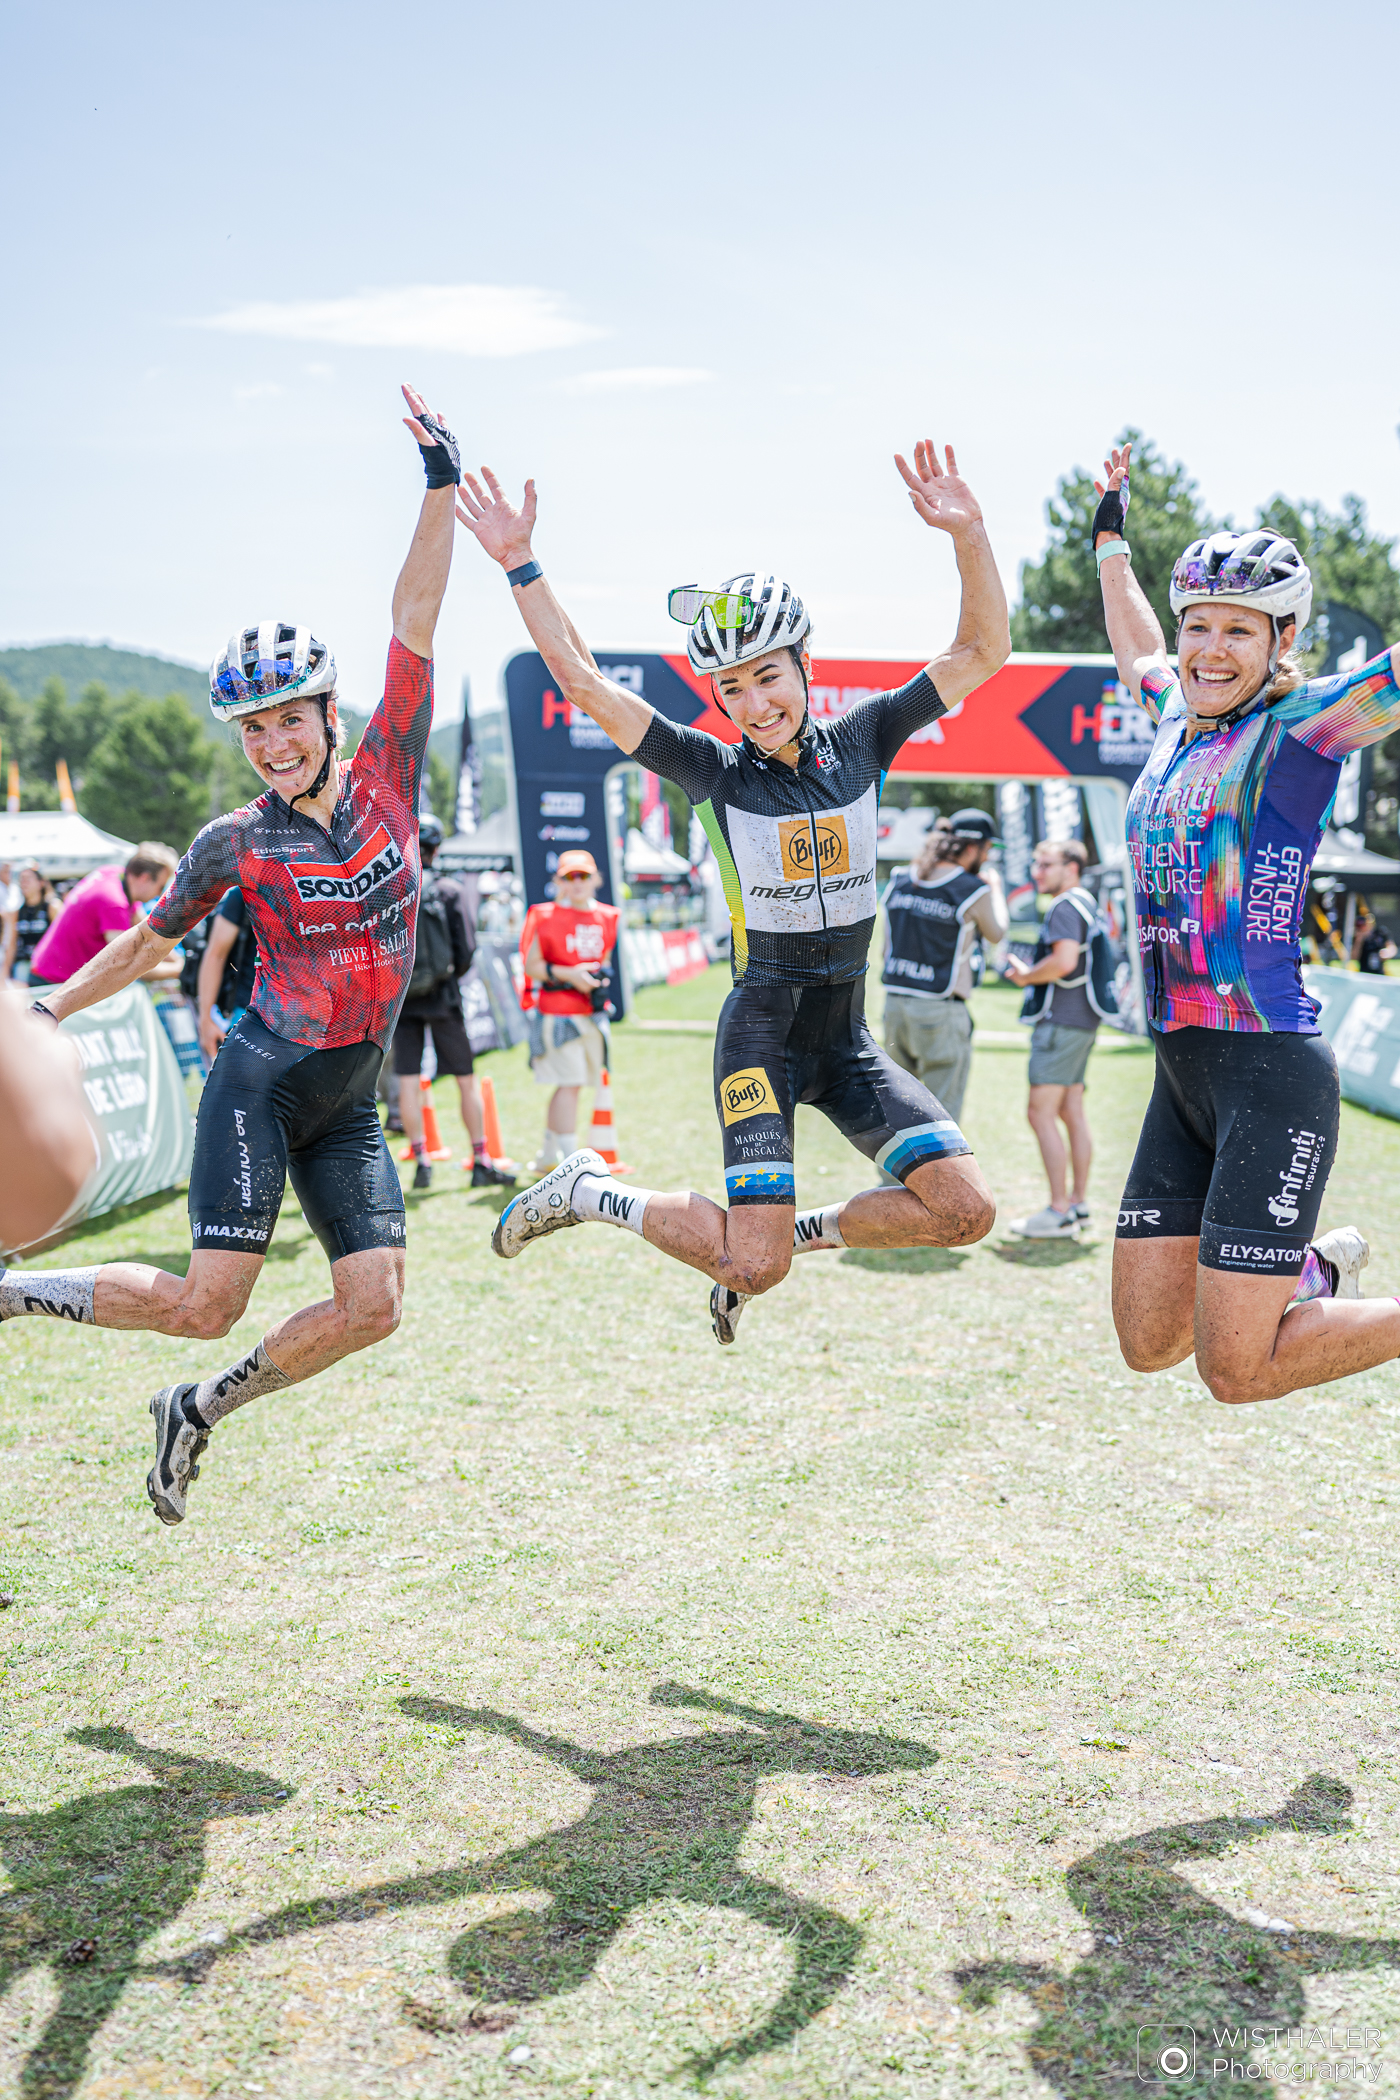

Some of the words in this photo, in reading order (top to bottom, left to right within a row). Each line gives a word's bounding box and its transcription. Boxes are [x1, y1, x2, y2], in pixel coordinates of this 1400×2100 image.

[343, 799, 373, 843] URSUS
[297, 847, 404, 900] SOUDAL
[1272, 846, 1303, 945] EFFICIENT
[328, 946, 370, 967] PIEVE
[379, 927, 410, 956] SALTI
[240, 1038, 276, 1061] PISSEI
[734, 1129, 781, 1146] MARQUÉS
[742, 1146, 779, 1158] RISCAL
[203, 1225, 269, 1242] MAXXIS
[1219, 1243, 1303, 1263] ELYSATOR
